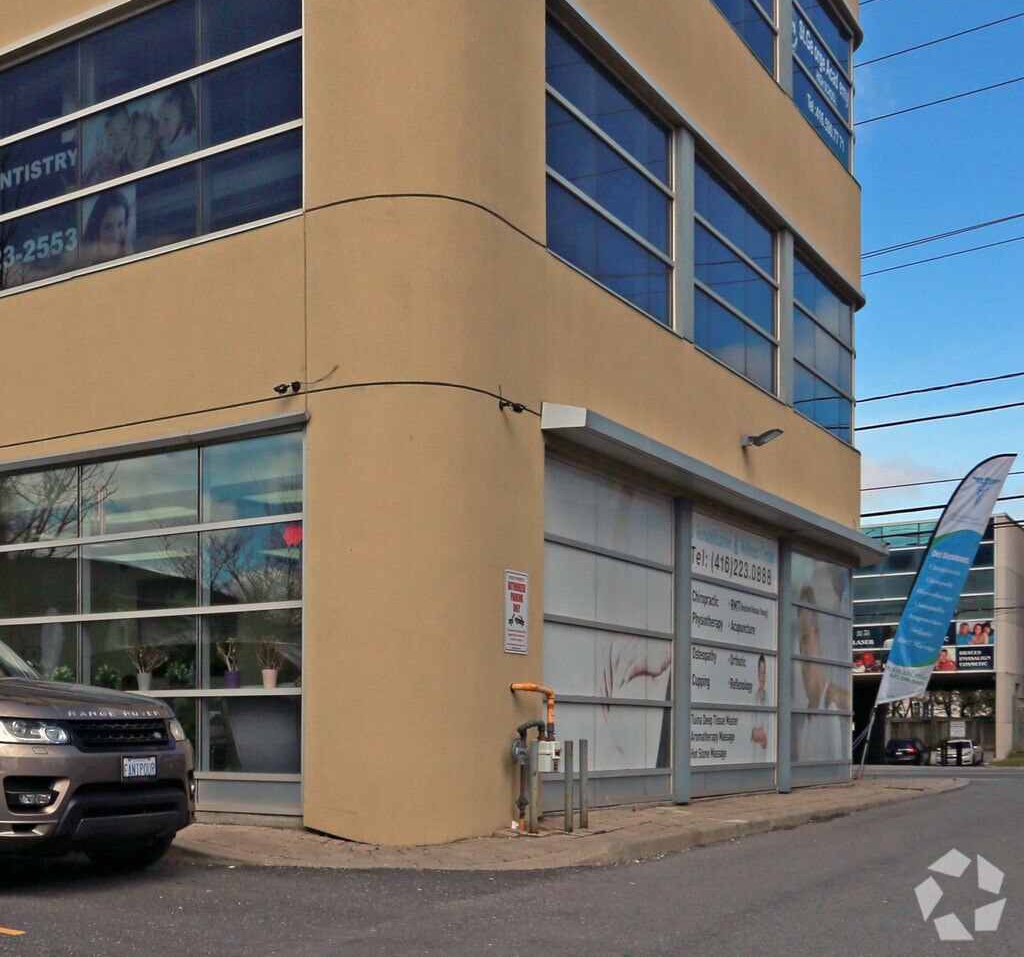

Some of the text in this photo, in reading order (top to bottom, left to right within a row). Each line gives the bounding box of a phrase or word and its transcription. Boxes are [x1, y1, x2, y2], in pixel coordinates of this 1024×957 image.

[690, 546, 772, 586] Tel: (416)223.0888
[692, 589, 720, 609] Chiropractic
[692, 611, 724, 633] Physiotherapy
[730, 620, 756, 636] Acupuncture
[692, 647, 717, 665] Osteopathy
[692, 673, 711, 691] Cupping
[730, 677, 754, 694] Reflexology
[67, 710, 117, 718] RANGE
[702, 714, 713, 728] Deep
[713, 714, 726, 726] Tissue
[691, 731, 736, 744] Aromatherapy Massage
[710, 748, 727, 761] Massage
